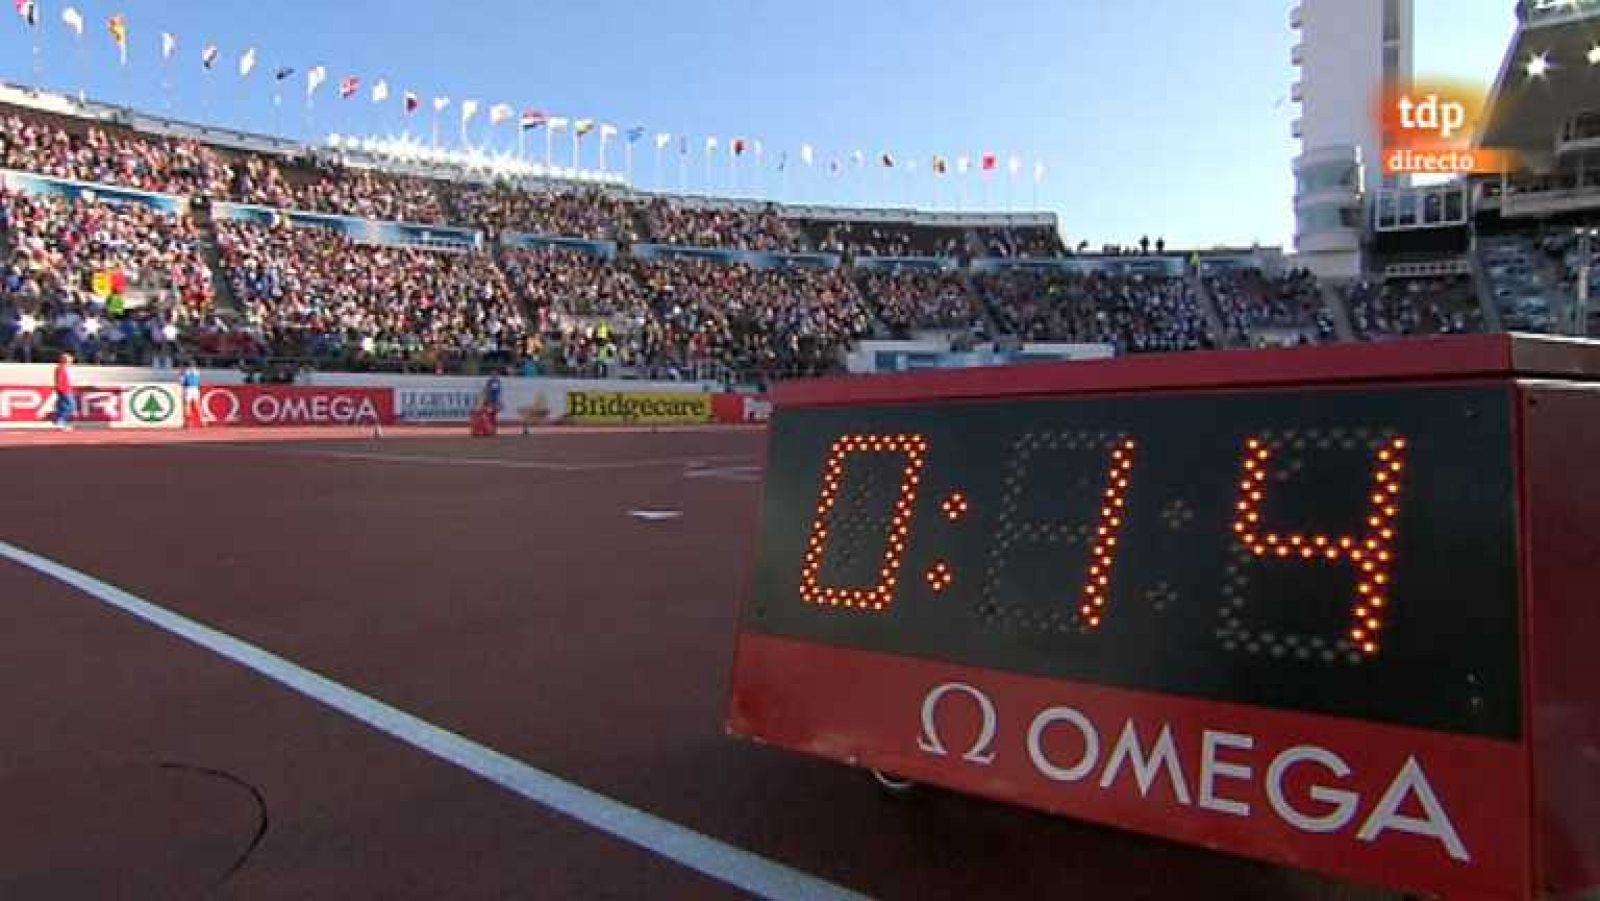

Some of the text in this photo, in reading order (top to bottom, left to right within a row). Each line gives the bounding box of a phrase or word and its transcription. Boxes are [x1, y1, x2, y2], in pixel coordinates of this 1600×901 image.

[251, 395, 380, 423] OMEGA
[566, 391, 706, 419] Bridgecare
[1026, 706, 1471, 862] OMEGA
